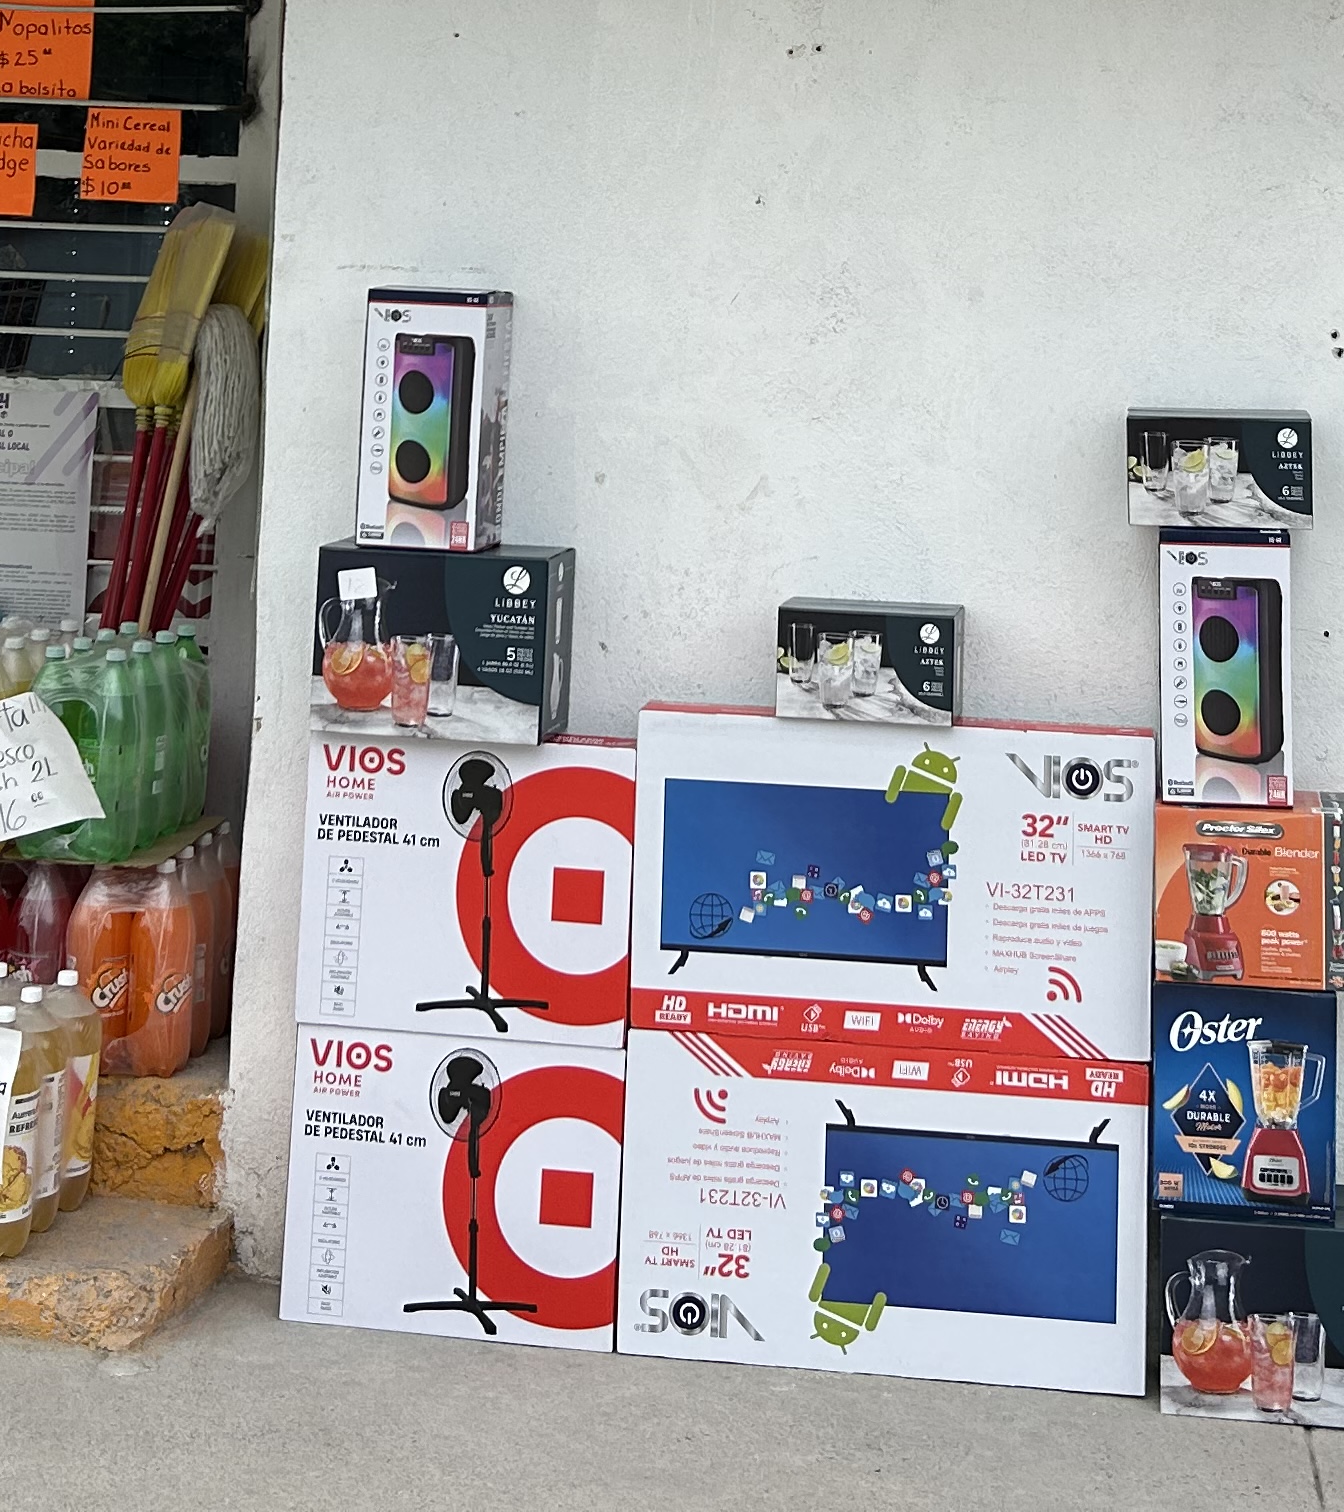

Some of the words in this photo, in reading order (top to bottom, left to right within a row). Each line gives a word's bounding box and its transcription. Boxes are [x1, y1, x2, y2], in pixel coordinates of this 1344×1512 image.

[89, 112, 120, 131] Mini
[122, 115, 171, 133] Cereal
[87, 136, 152, 154] Variedad
[154, 141, 172, 156] de
[7, 441, 31, 451] LOCAL
[1281, 485, 1290, 496] 6
[490, 613, 536, 625] YUCATÁN
[506, 646, 516, 661] 5
[922, 681, 931, 692] 6
[322, 743, 407, 776] VIOS
[326, 775, 377, 791] HOME
[1005, 752, 1136, 803] VIOS
[326, 790, 340, 799] AIR
[341, 791, 374, 800] POWER
[318, 813, 398, 831] VENTILADOR
[1077, 823, 1114, 835] SMART
[1116, 825, 1130, 835] TV
[1201, 823, 1246, 833] Proctor
[317, 828, 334, 841] DE
[337, 828, 400, 846] PEDESTAL
[402, 833, 416, 847] 41
[419, 835, 440, 848] cm
[1094, 834, 1113, 845] HD
[1020, 851, 1046, 863] LED
[1050, 852, 1068, 864] TV
[1274, 846, 1320, 859] Blender
[986, 881, 1074, 903] VI-32T231
[662, 994, 687, 1012] HD
[658, 1012, 689, 1022] READY
[707, 1001, 779, 1021] HDMI
[800, 1023, 819, 1034] USB
[912, 1013, 945, 1029] Dolby
[1168, 1010, 1263, 1053] Oster
[309, 1037, 394, 1073] VIOS
[828, 1062, 859, 1079] Dolby
[313, 1070, 363, 1088] HOME
[995, 1069, 1069, 1090] HDMI
[313, 1086, 327, 1095] AIR
[329, 1087, 361, 1098] POWER
[1090, 1080, 1117, 1099] HD
[1198, 1089, 1216, 1103] 4X
[305, 1108, 384, 1129] VENTILADOR
[1186, 1110, 1231, 1124] DURABLE
[303, 1123, 321, 1138] DE
[323, 1125, 385, 1145] PEDESTAL
[388, 1131, 403, 1146] 41
[406, 1134, 427, 1148] cm
[699, 1187, 787, 1210] VI-32T231
[706, 1227, 724, 1239] TV
[727, 1228, 752, 1240] LED
[661, 1246, 679, 1257] HD
[644, 1255, 658, 1266] TV
[660, 1256, 696, 1269] SMART
